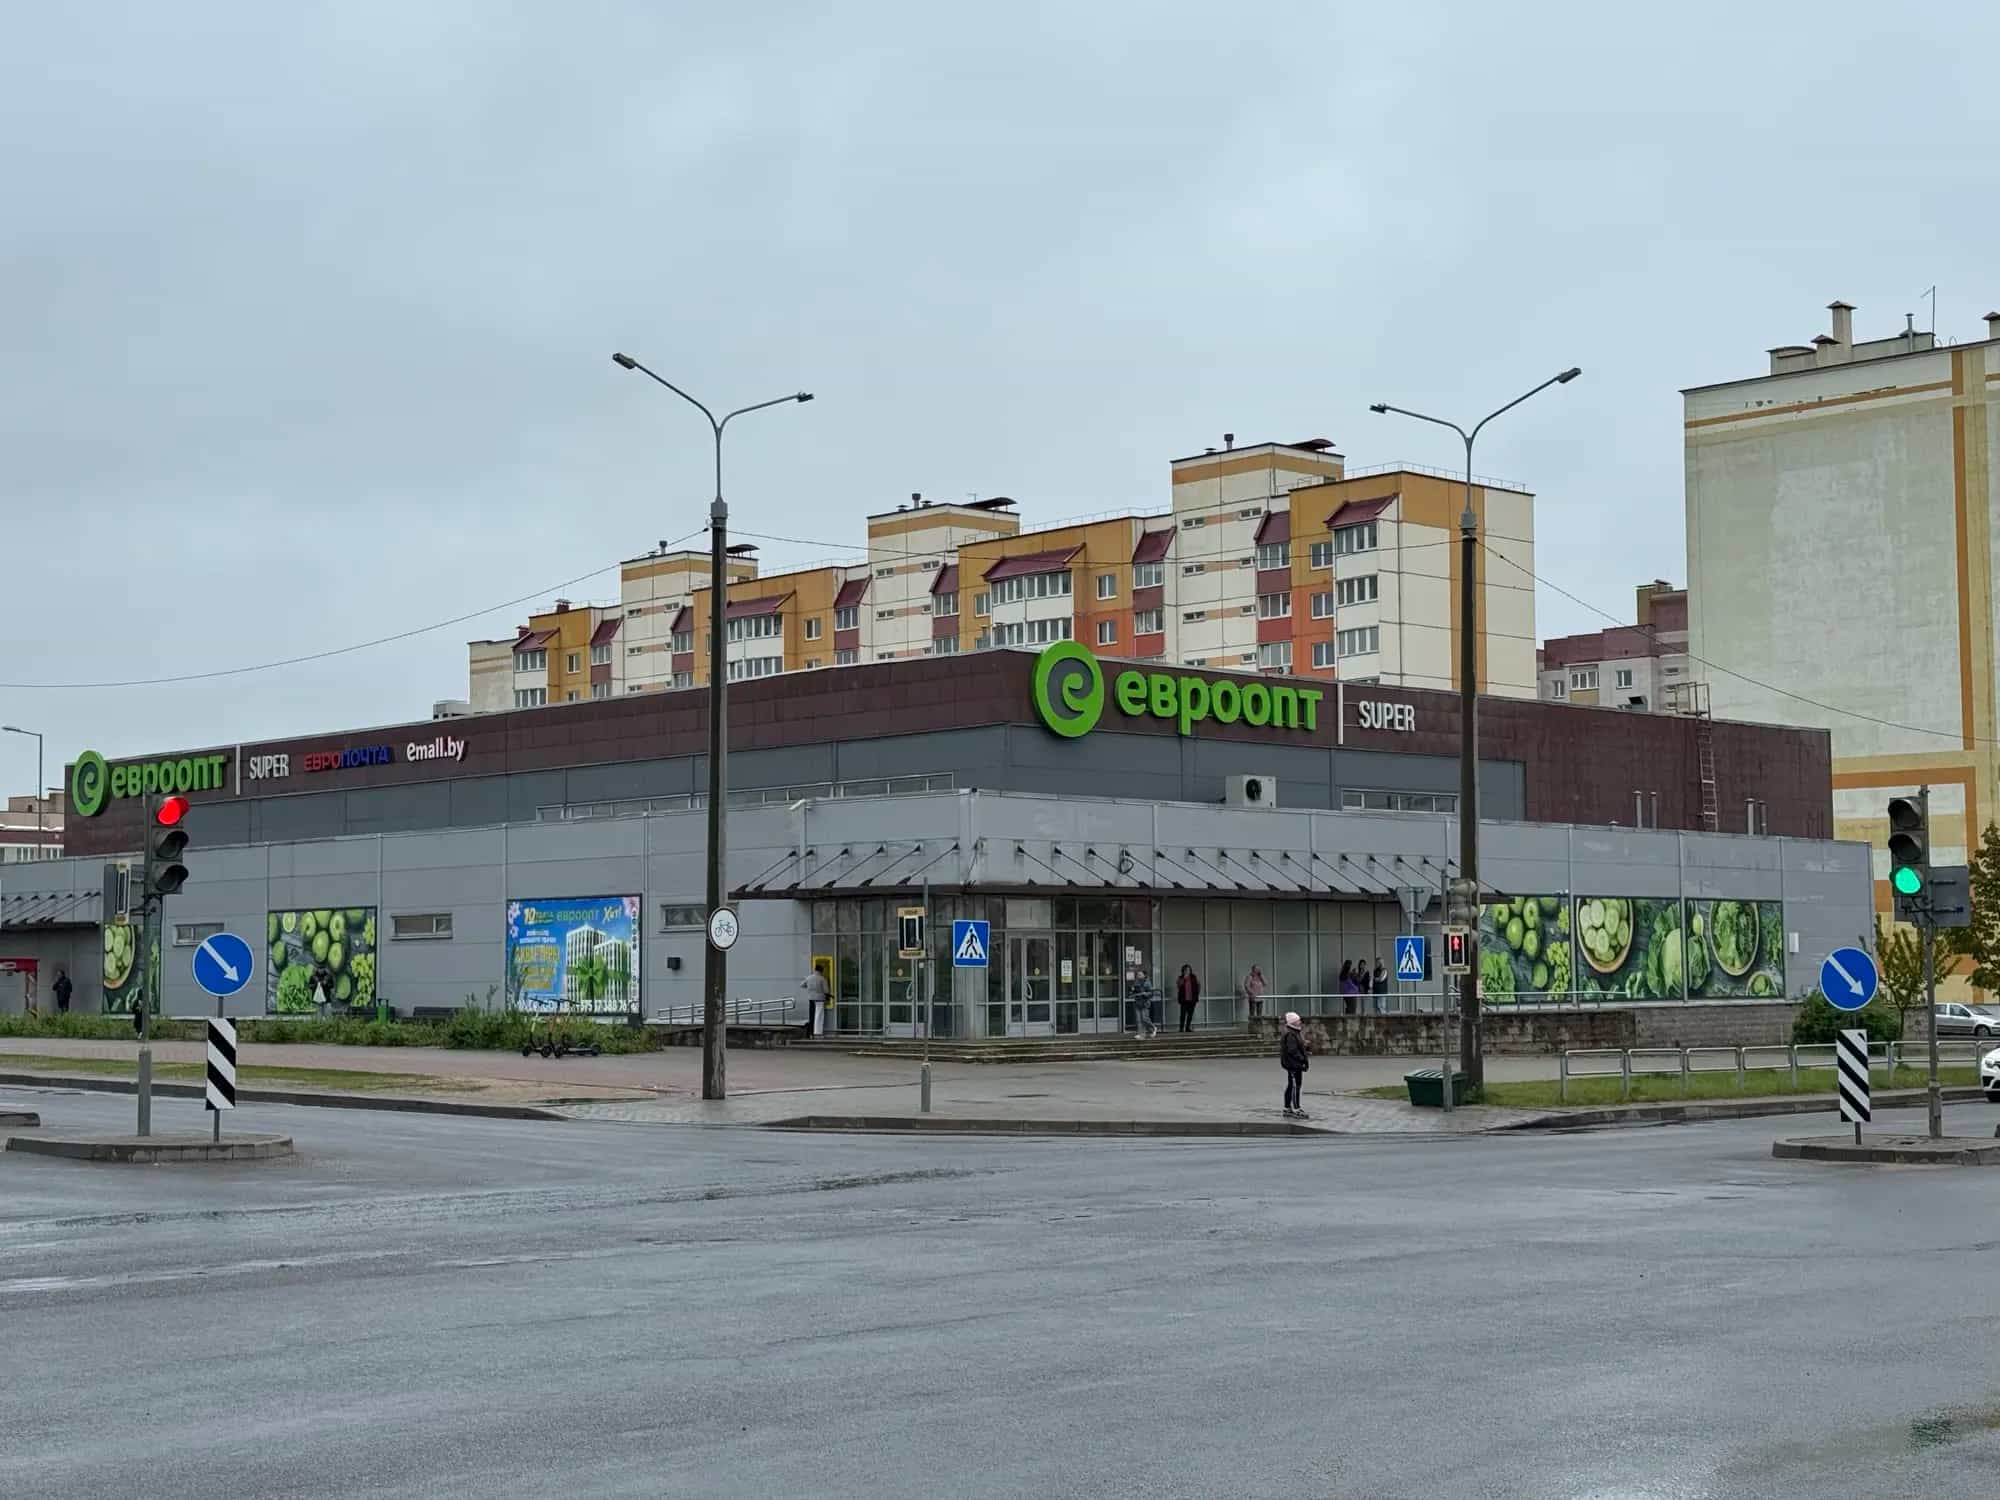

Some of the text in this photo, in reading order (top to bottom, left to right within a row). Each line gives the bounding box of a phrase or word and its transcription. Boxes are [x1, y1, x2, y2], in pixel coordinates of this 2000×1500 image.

[1114, 669, 1324, 737] евроопт
[1357, 700, 1416, 732] SUPER
[302, 744, 391, 772] ЕВРОПОЧТА
[406, 735, 465, 762] emall.by
[110, 754, 227, 800] евроопт
[249, 753, 290, 780] SUPER
